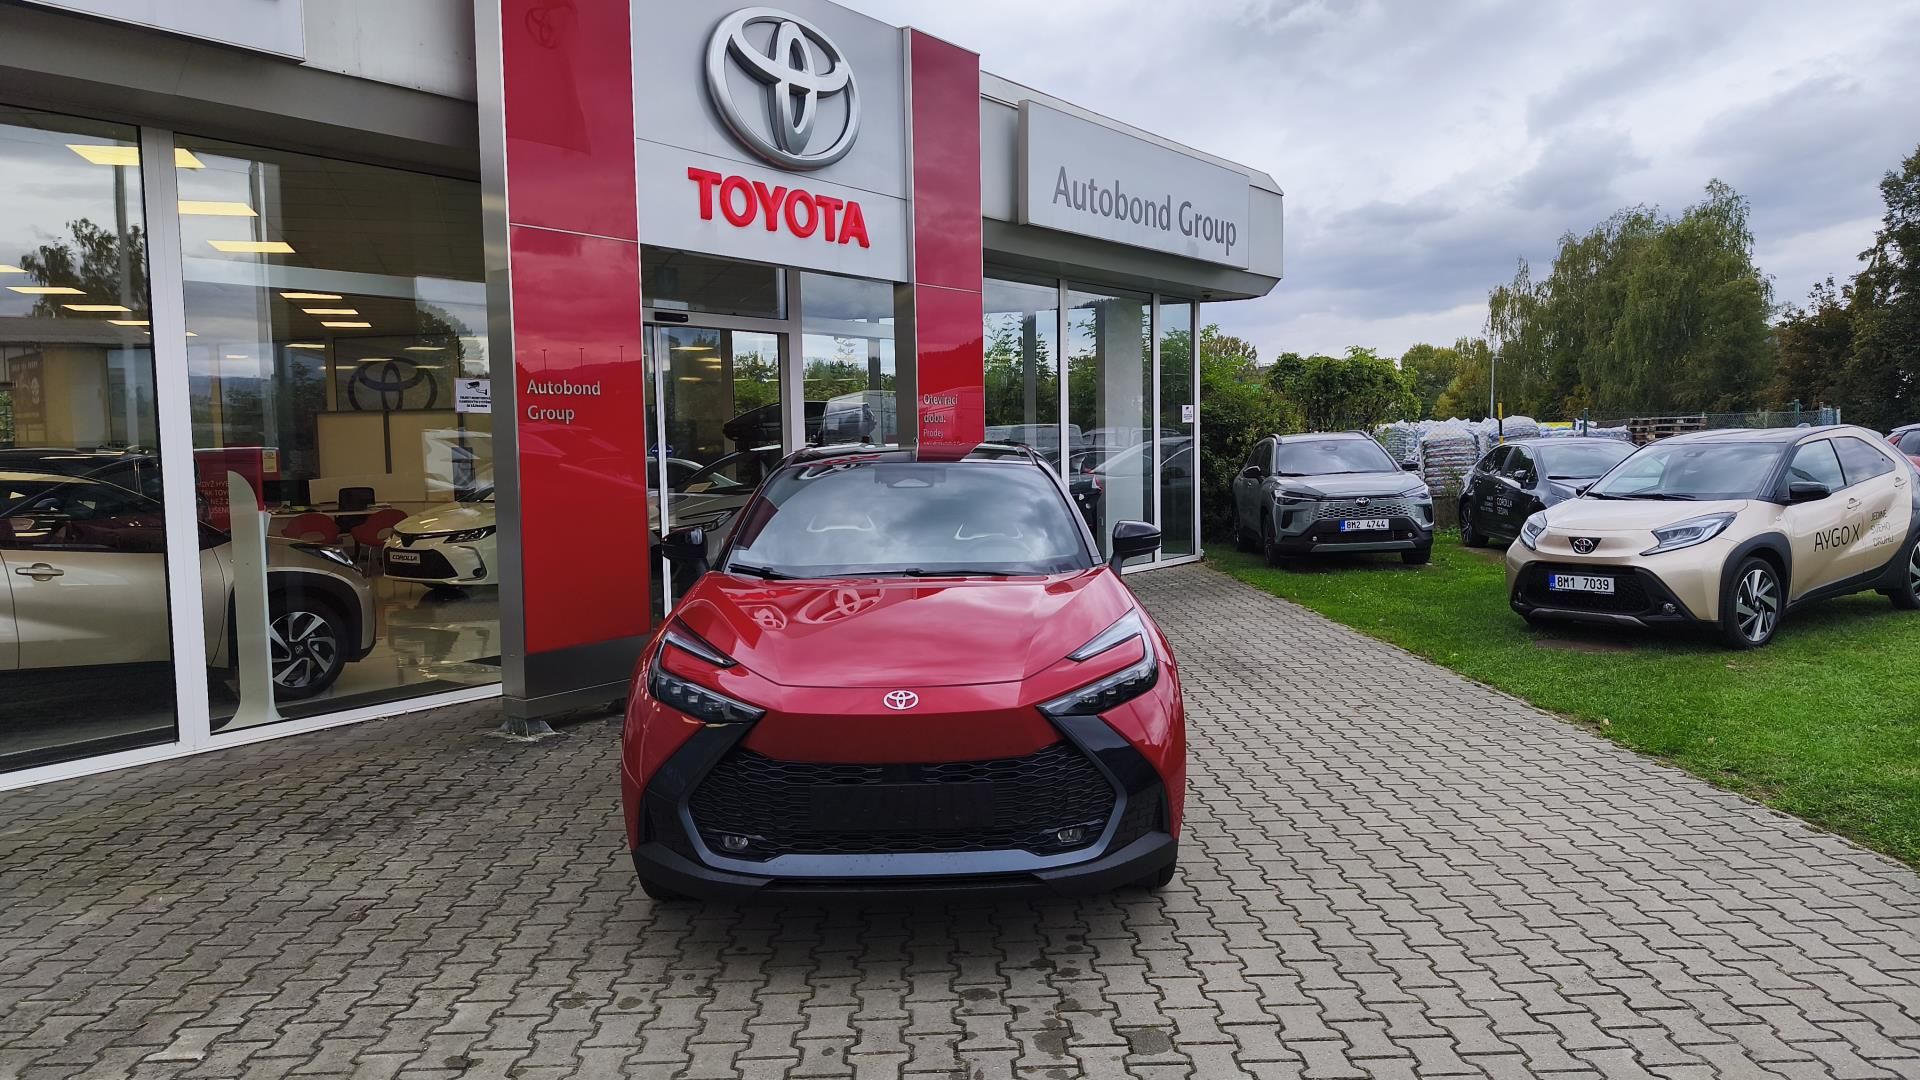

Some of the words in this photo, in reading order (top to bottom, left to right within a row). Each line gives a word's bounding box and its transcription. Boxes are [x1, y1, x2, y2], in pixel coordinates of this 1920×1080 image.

[688, 167, 870, 249] TOYOTA
[1053, 166, 1171, 231] Autobond
[1178, 201, 1237, 256] Group
[527, 379, 601, 396] Autobond
[923, 394, 958, 405] Otevírací
[527, 405, 575, 424] Group
[923, 428, 944, 439] Prodej
[1346, 521, 1360, 529] 8M2
[1366, 520, 1385, 528] 4744
[1814, 526, 1850, 552] AYGO
[1851, 523, 1860, 542] X
[1557, 576, 1575, 588] 8M1
[1583, 577, 1609, 590] 7039
